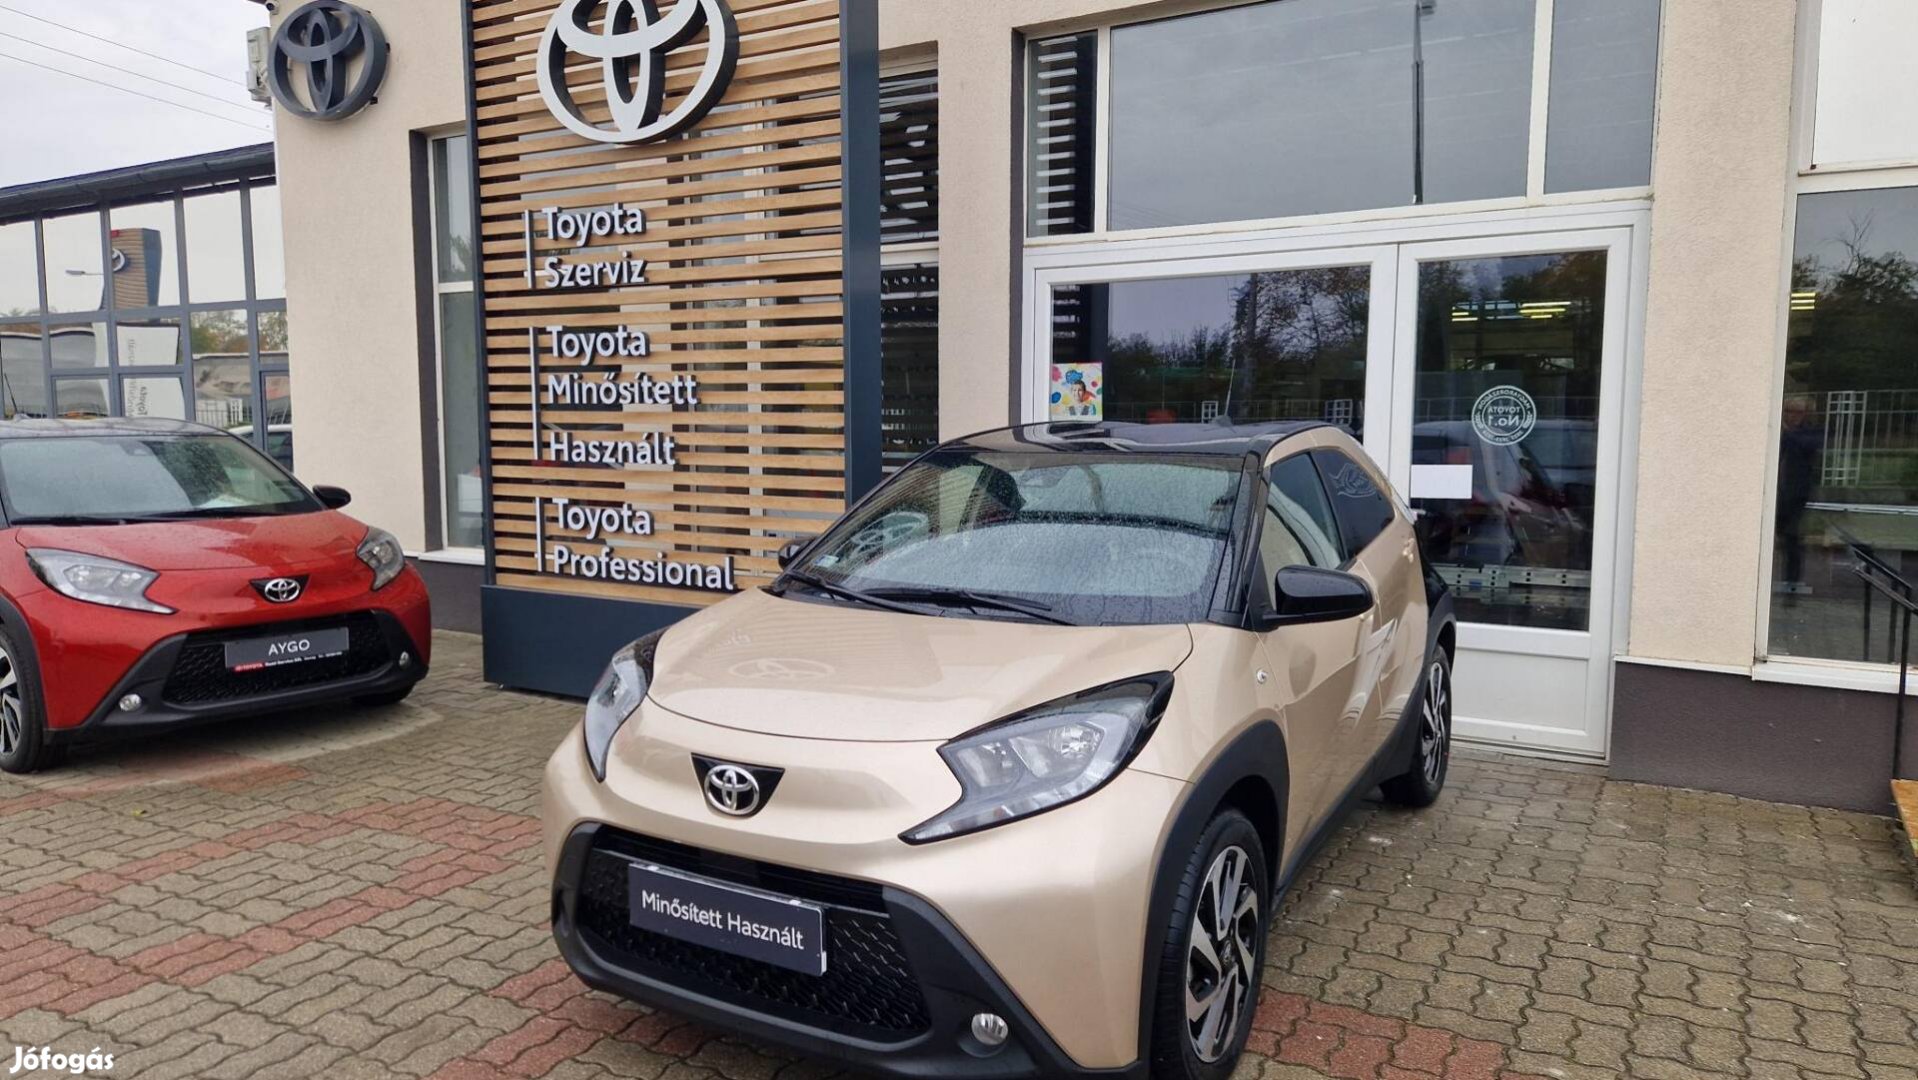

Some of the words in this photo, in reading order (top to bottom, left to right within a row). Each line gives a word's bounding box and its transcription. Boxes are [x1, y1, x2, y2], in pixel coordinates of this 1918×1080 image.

[541, 203, 643, 247] Toyota
[544, 251, 645, 288] Szerviz
[546, 324, 647, 366] Toyota
[547, 372, 698, 405] Minősített
[550, 431, 676, 465] Használt
[552, 498, 652, 540] Toyota
[553, 545, 736, 590] Professional
[268, 639, 311, 656] AYGO
[641, 889, 723, 929] Minősített
[727, 912, 804, 950] Használt
